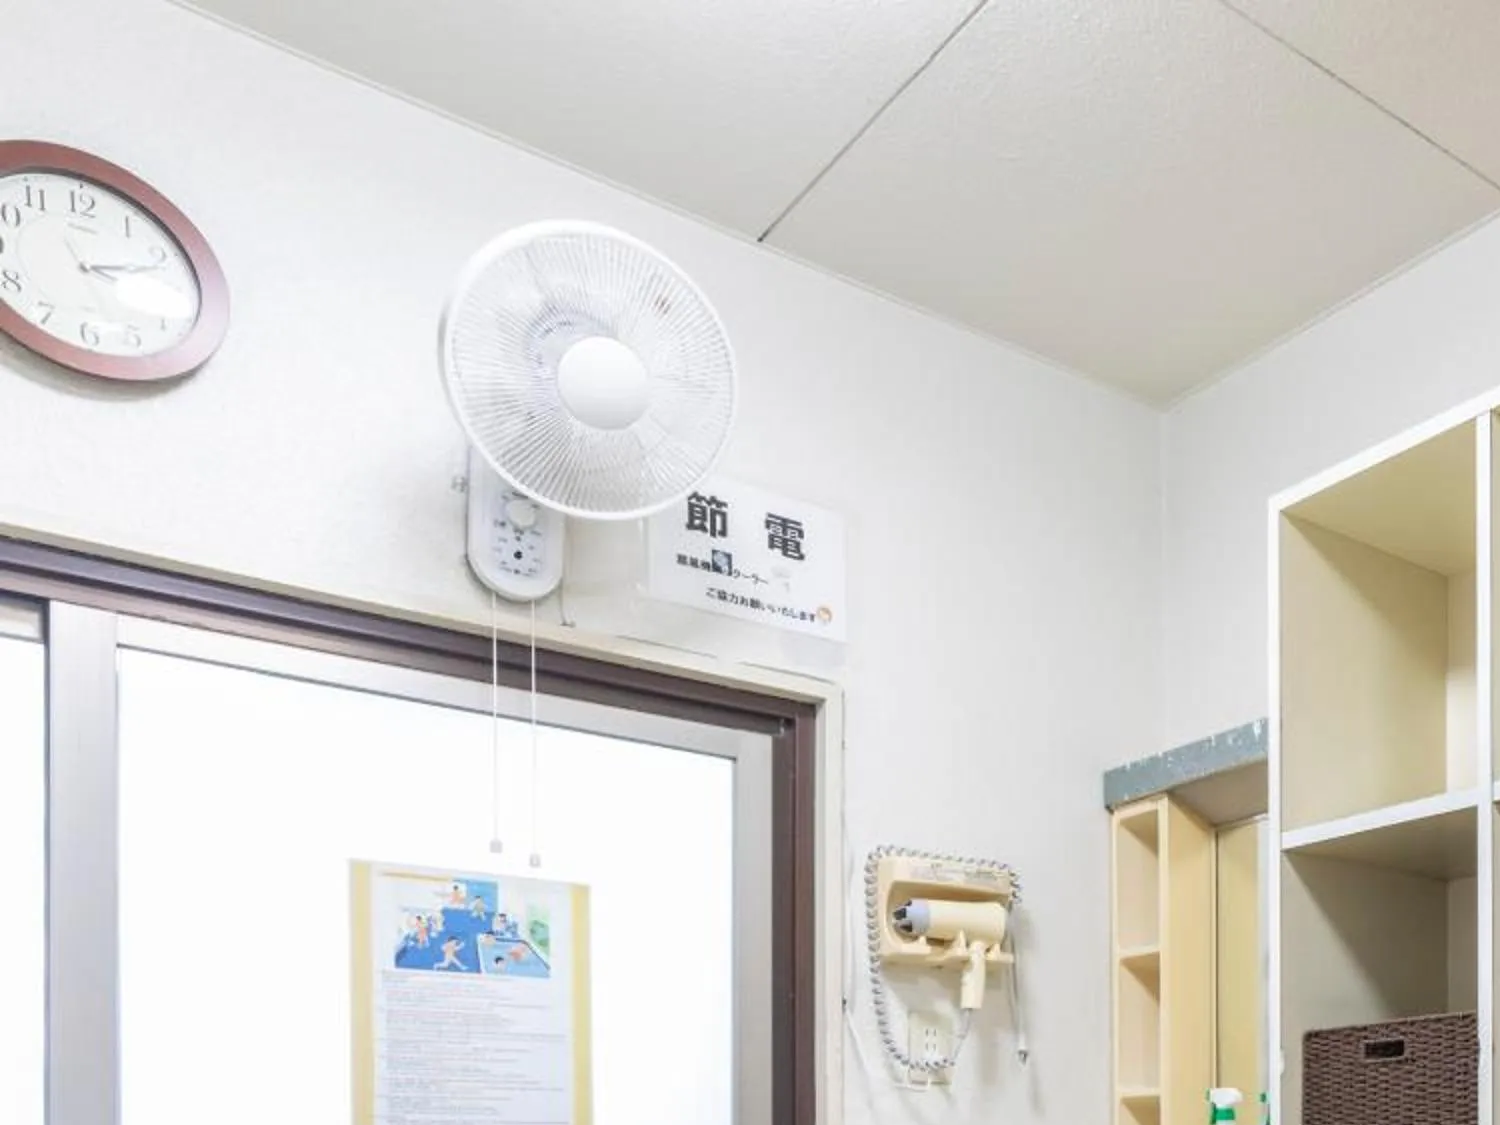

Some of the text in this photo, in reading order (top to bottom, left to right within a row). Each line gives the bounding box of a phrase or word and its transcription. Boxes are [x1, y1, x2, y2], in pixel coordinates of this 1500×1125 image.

[24, 185, 46, 212] 11
[69, 190, 96, 219] 12
[37, 301, 55, 325] 7
[79, 321, 101, 347] 6
[122, 323, 143, 348] 5
